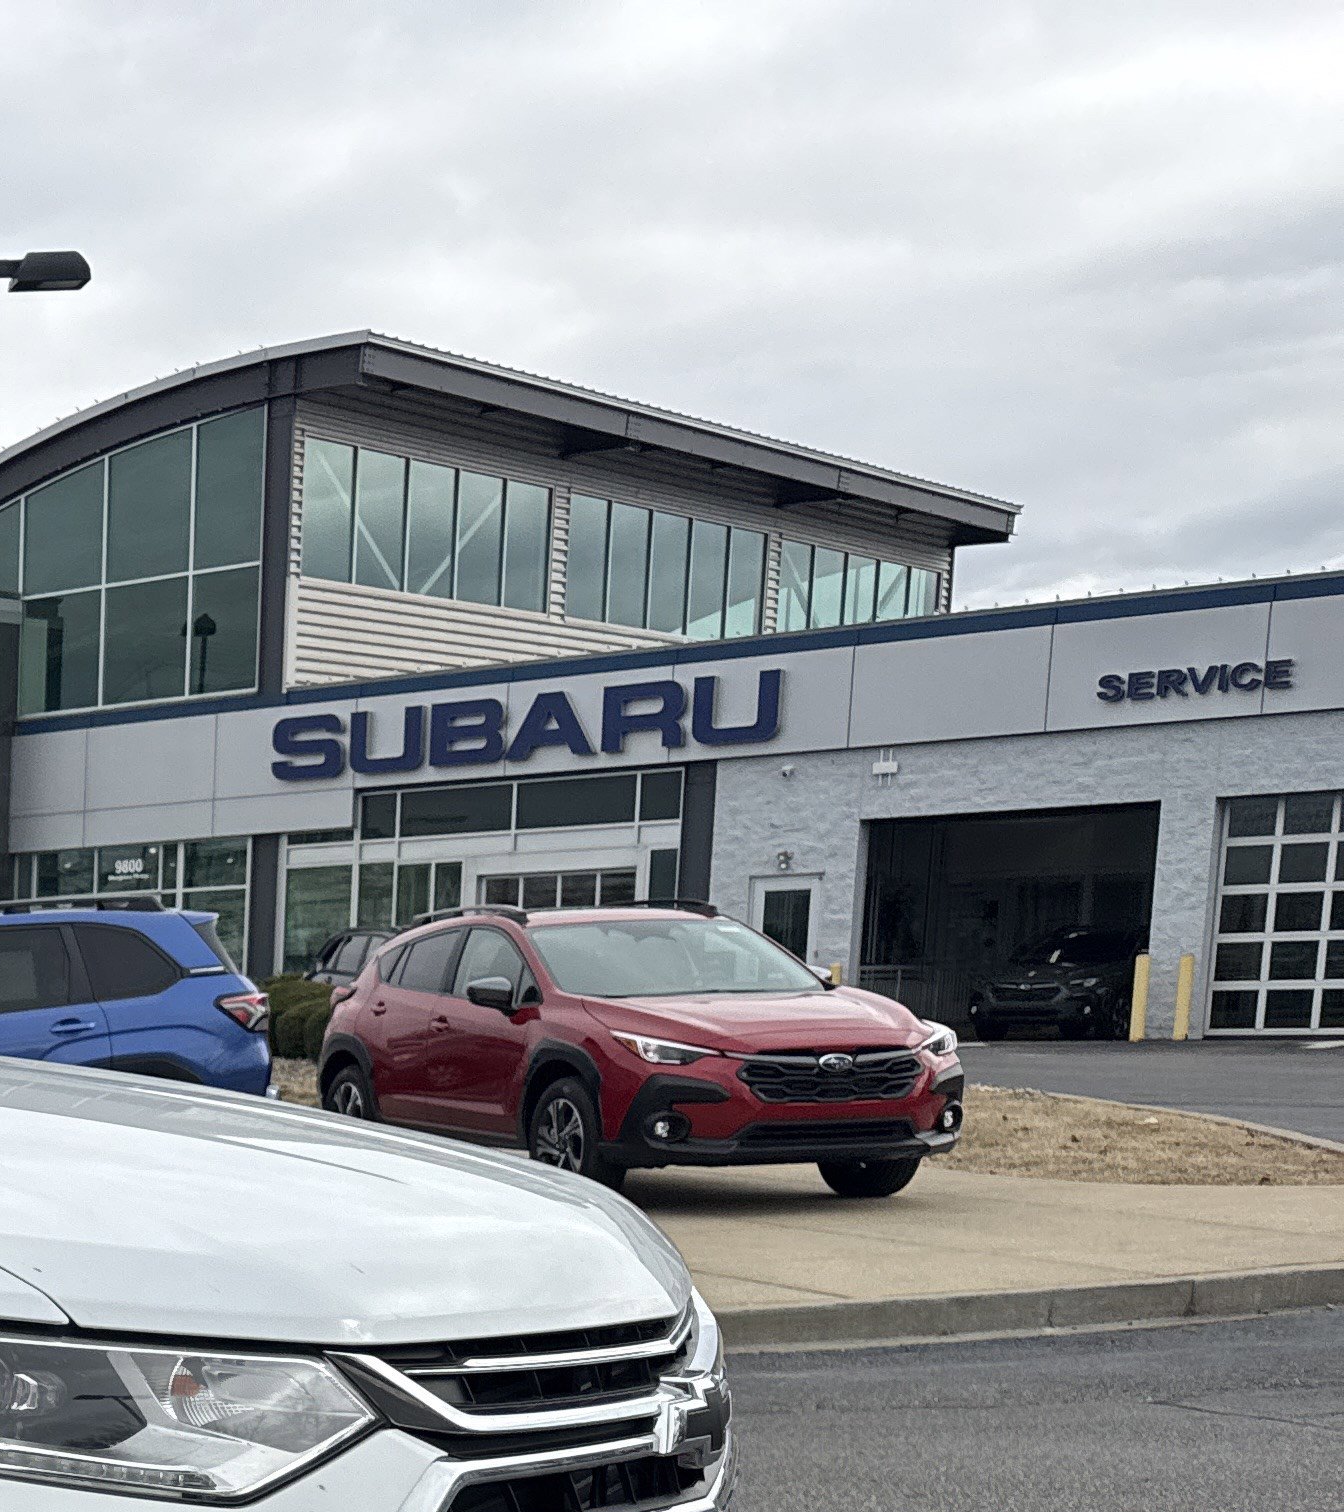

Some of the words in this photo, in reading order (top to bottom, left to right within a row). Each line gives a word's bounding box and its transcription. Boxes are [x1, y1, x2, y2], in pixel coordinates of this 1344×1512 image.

[1096, 658, 1294, 702] SERVICE
[270, 668, 784, 781] SUBARU
[114, 858, 144, 874] 9800
